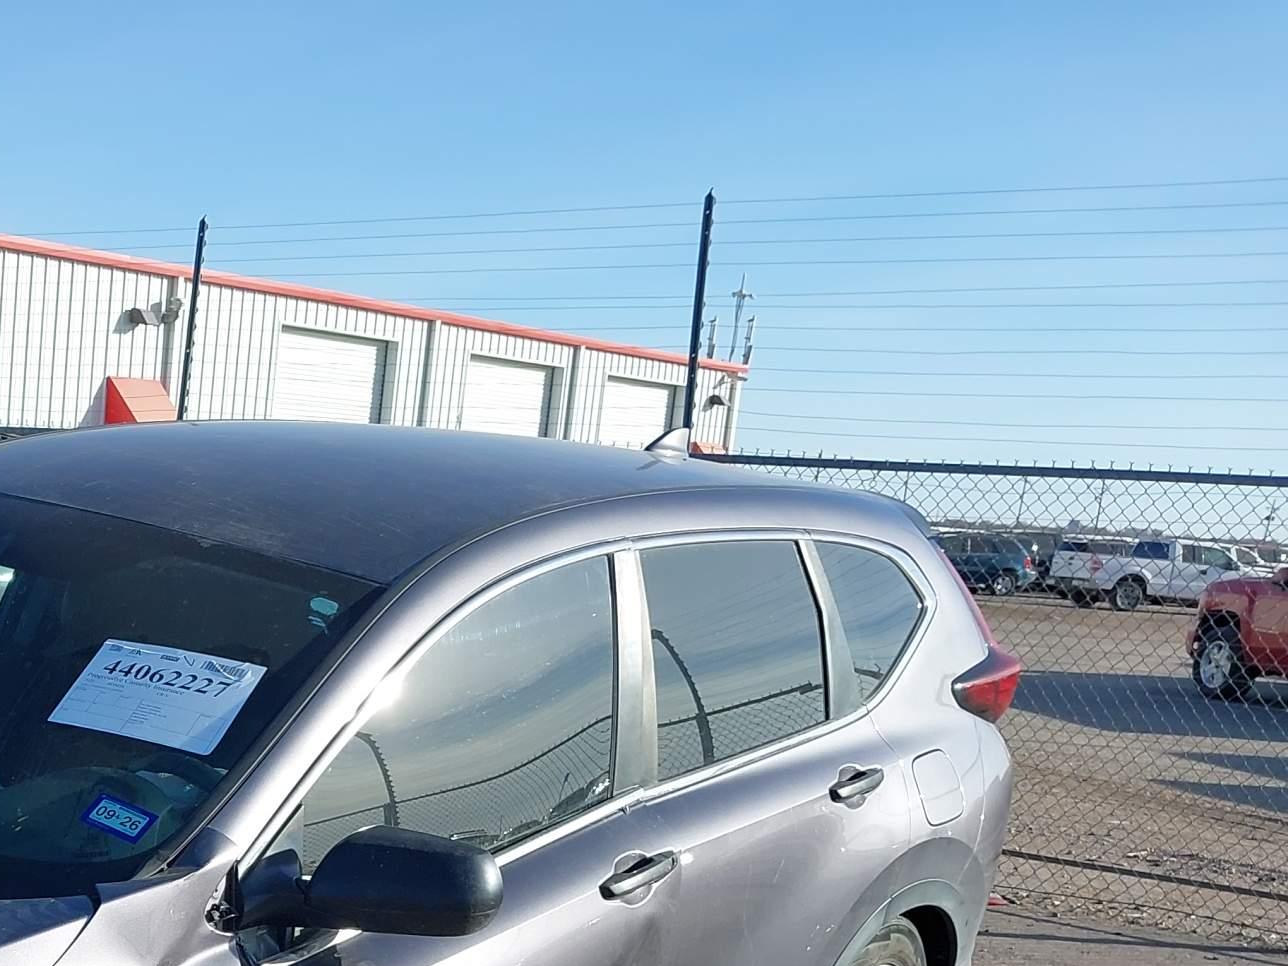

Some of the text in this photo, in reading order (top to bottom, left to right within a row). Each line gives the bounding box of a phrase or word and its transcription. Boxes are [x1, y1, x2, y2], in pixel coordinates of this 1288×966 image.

[103, 659, 238, 698] 44062227
[95, 805, 142, 831] 09 26
